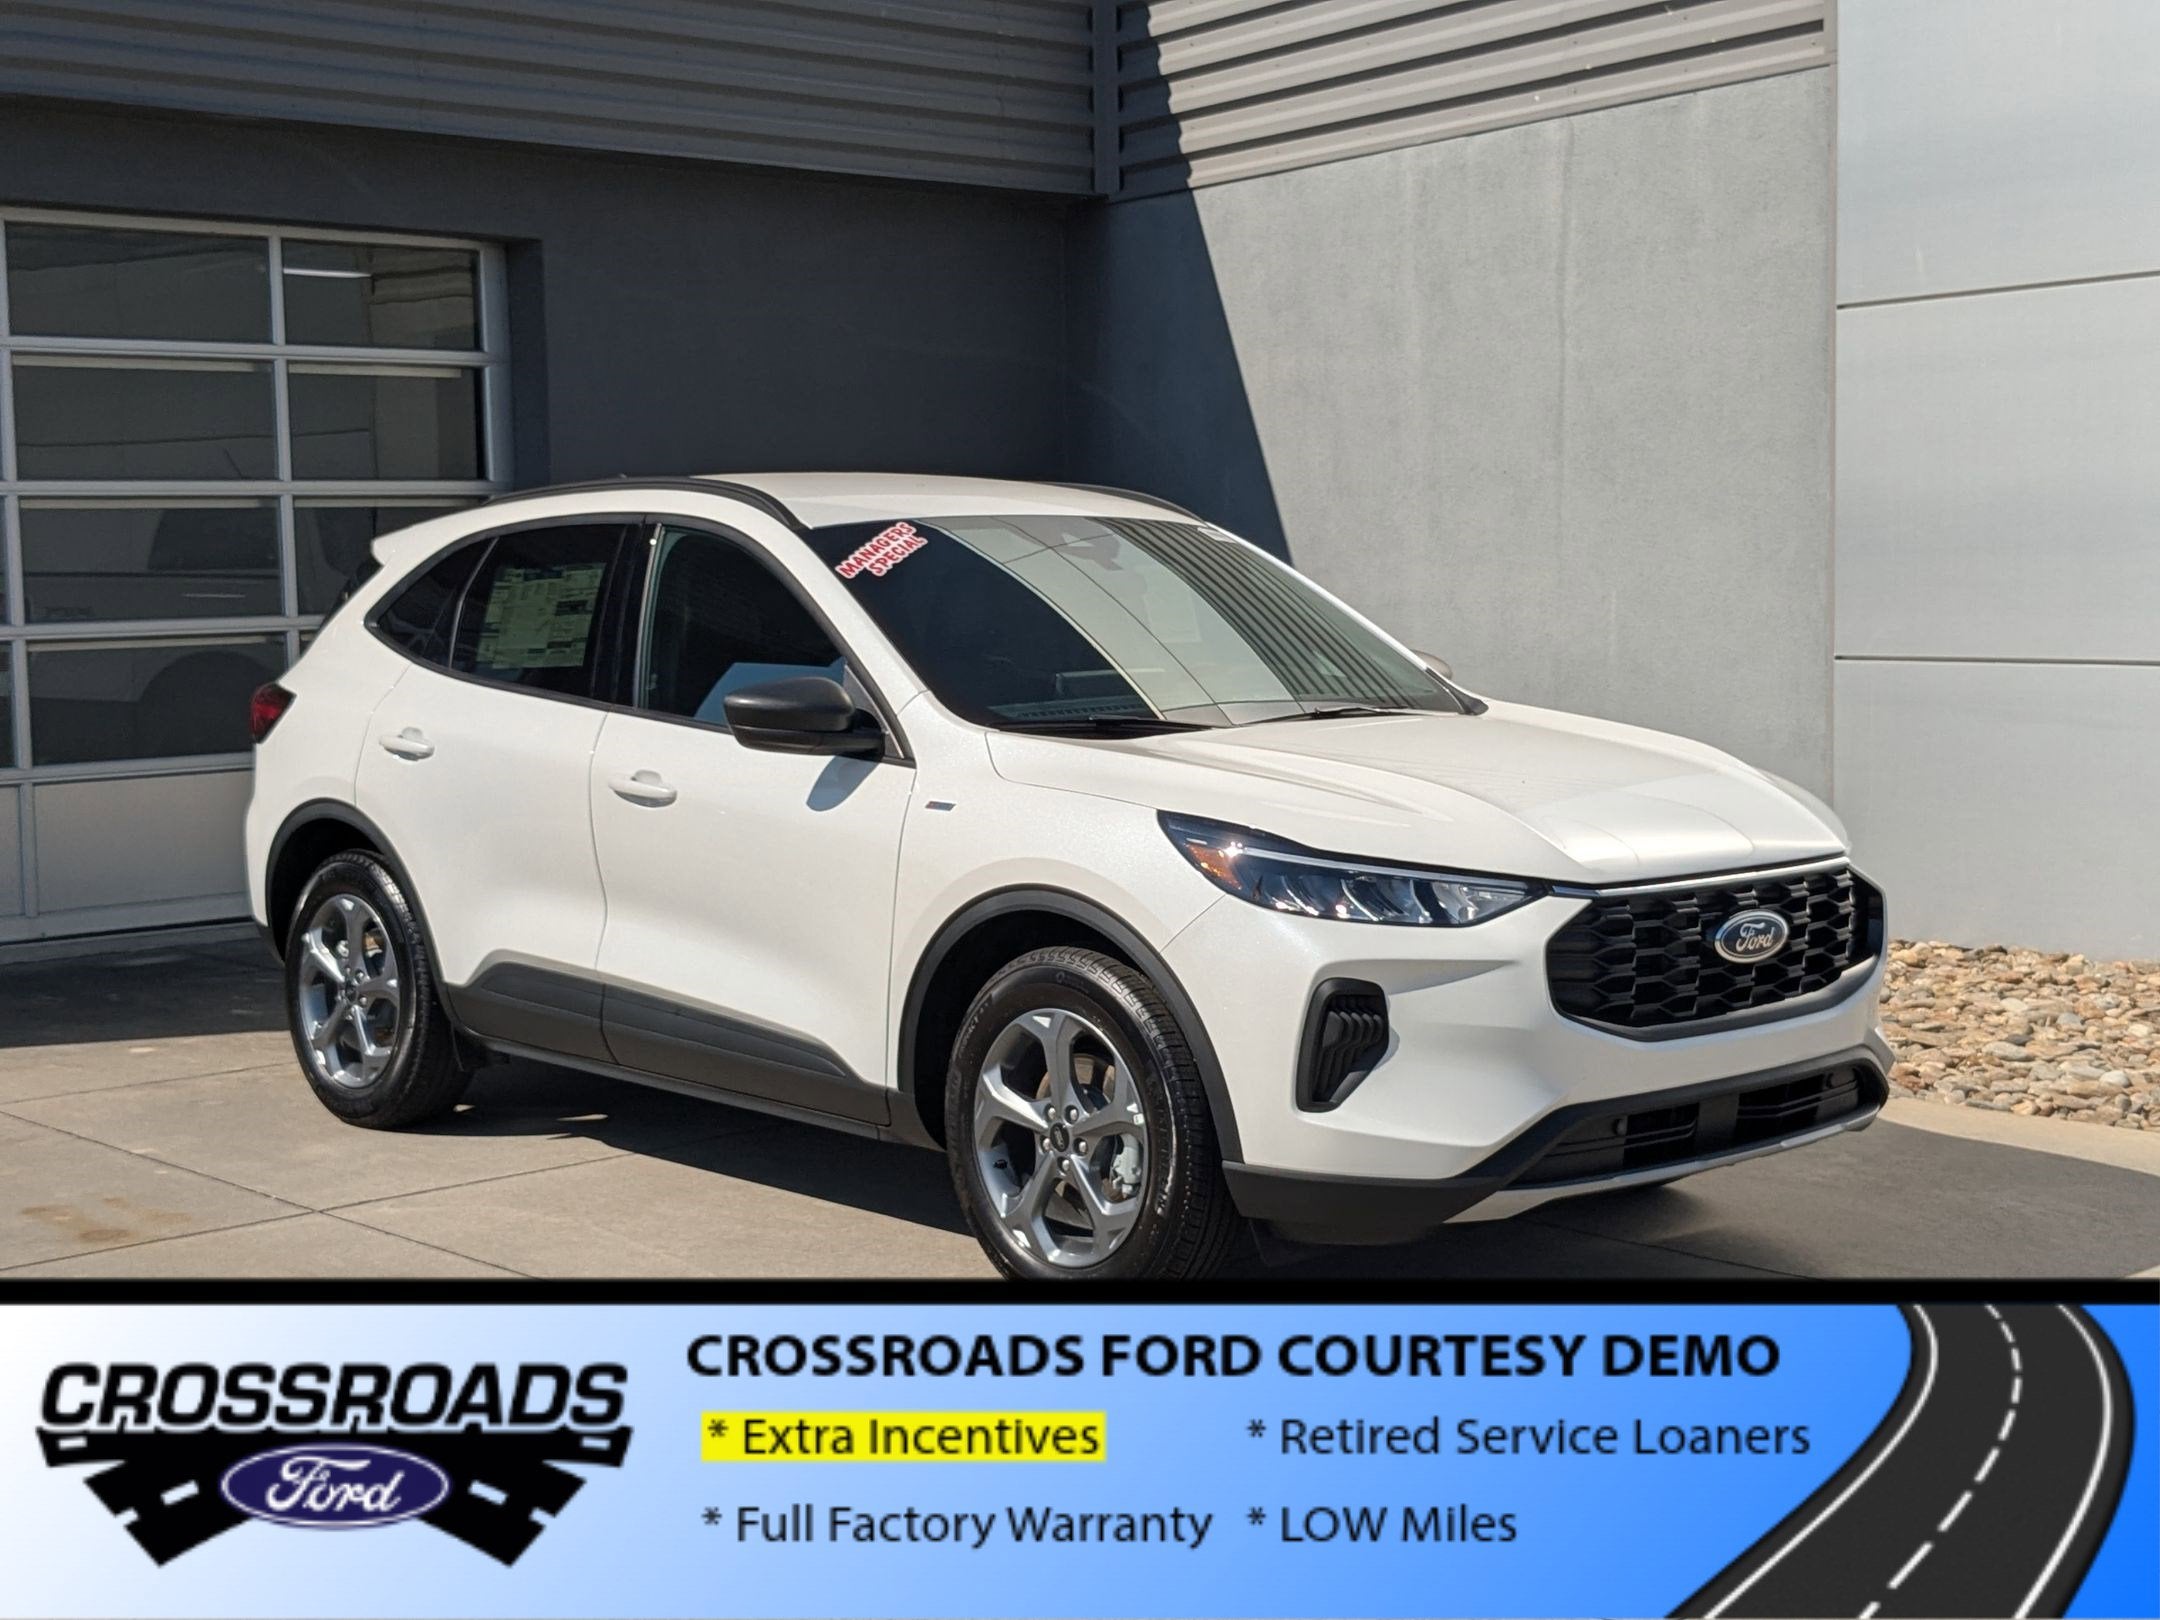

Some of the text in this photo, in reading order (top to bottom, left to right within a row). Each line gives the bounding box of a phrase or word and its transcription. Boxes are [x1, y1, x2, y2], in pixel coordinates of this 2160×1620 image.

[837, 522, 915, 577] MANAGERS
[867, 535, 926, 576] SPECIAL
[1736, 922, 1775, 952] Ford
